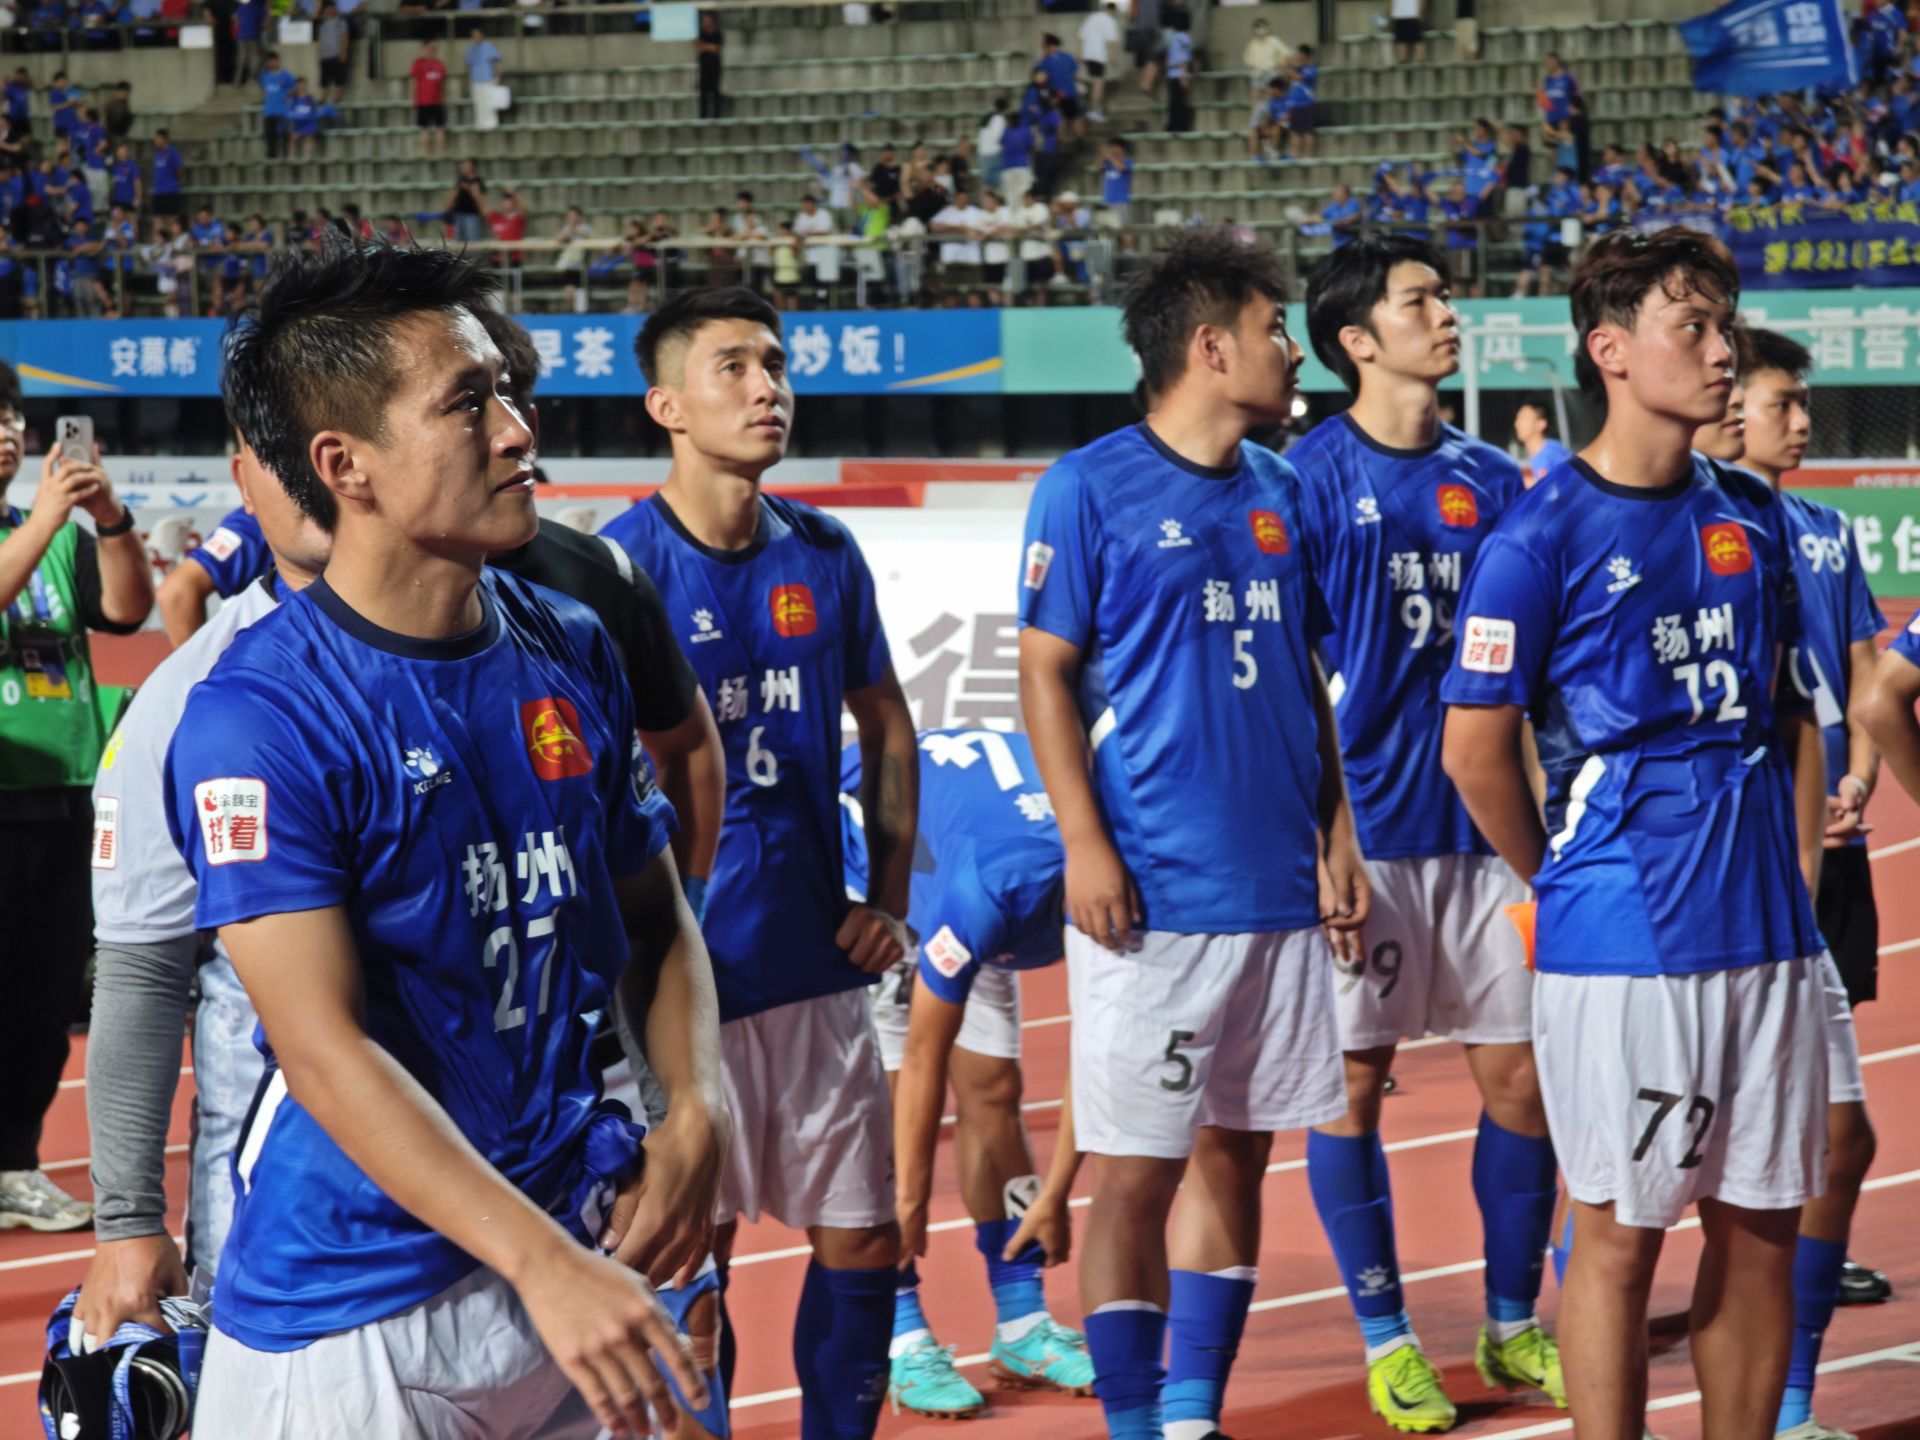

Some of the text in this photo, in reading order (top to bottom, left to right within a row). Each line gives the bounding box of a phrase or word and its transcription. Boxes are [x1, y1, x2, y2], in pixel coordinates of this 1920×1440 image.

[110, 336, 198, 377] 安慕希
[530, 327, 615, 378] 早茶
[1387, 551, 1461, 592] 扬州
[1799, 533, 1846, 573] 98
[1203, 579, 1281, 622] 扬州
[1401, 594, 1454, 649] 99
[1232, 629, 1258, 690] 5
[1651, 603, 1736, 664] 扬州
[717, 665, 801, 723] 扬州
[1672, 659, 1747, 725] 72
[413, 771, 452, 795] KELME
[745, 725, 779, 787] 6
[462, 825, 577, 918] 扬州
[483, 906, 561, 1032] 27
[1160, 1030, 1195, 1092] 5
[1632, 1088, 1715, 1168] 72
